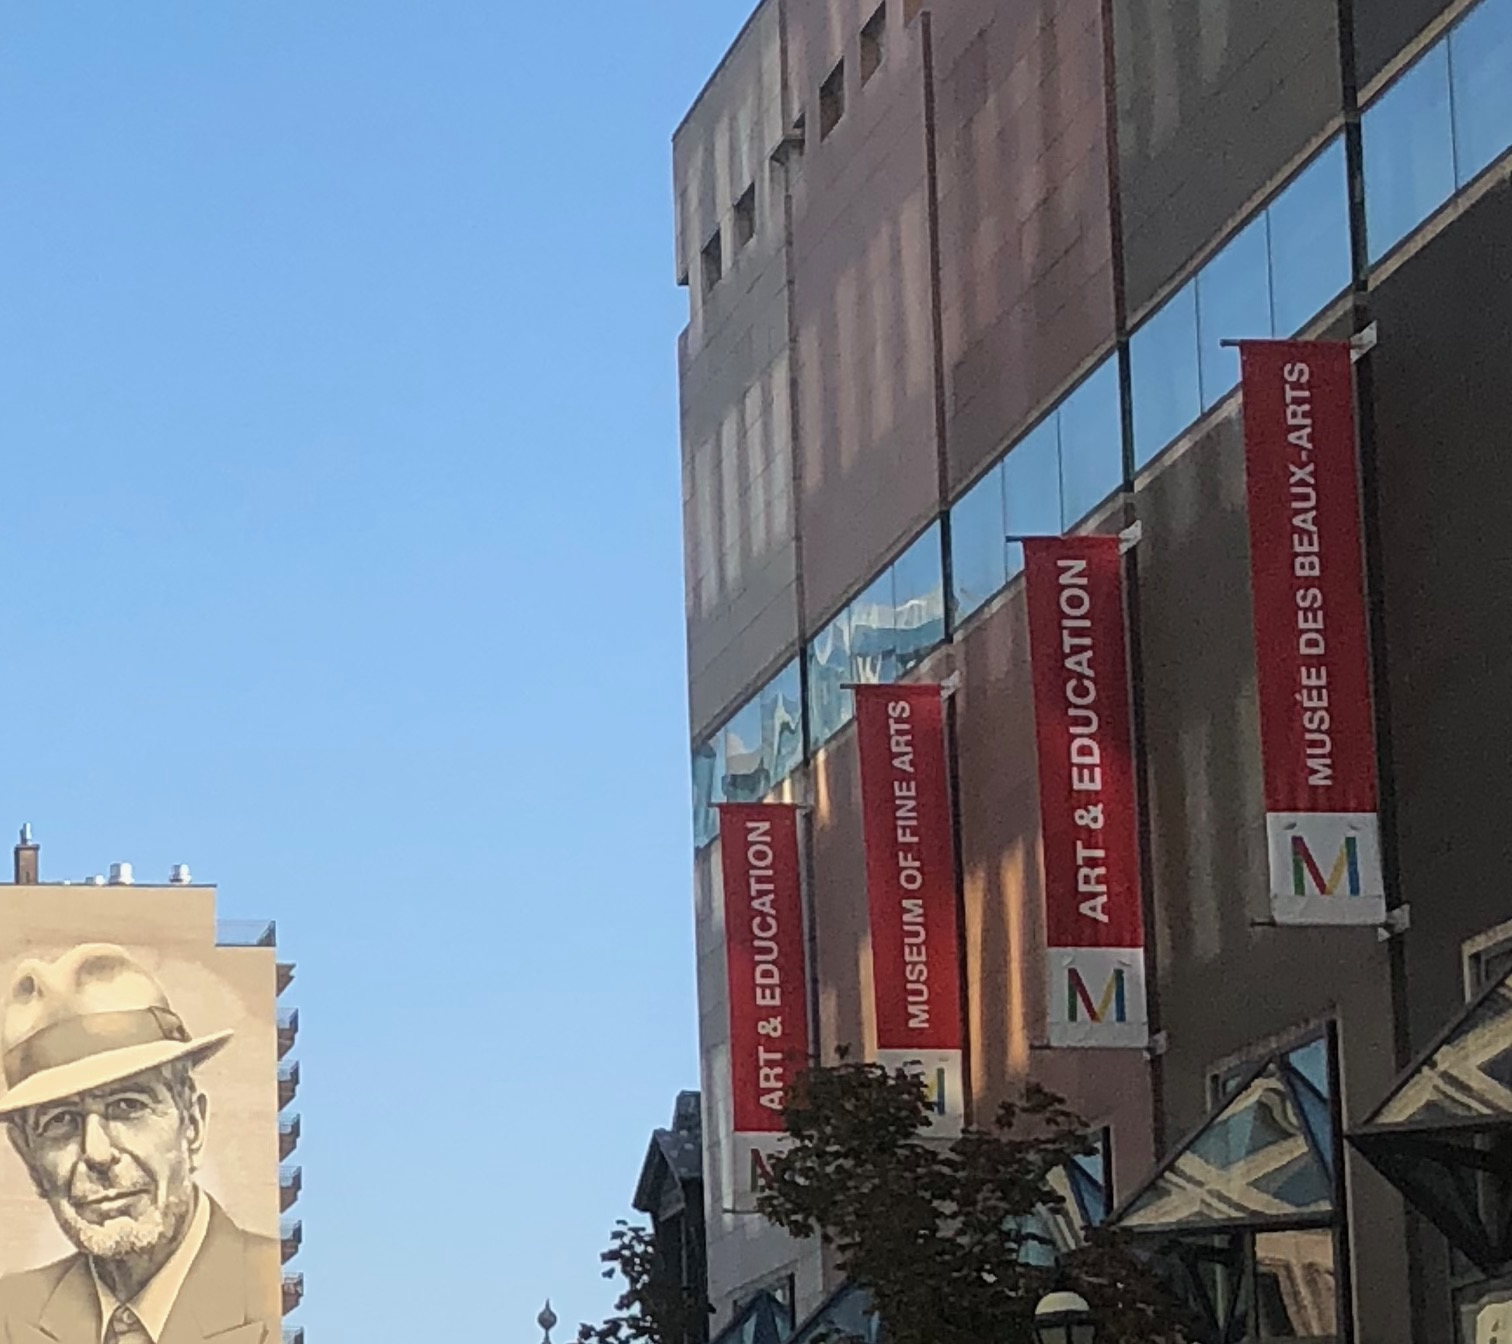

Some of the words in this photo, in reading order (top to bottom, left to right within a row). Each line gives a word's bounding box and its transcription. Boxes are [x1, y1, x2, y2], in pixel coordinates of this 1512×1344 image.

[1283, 362, 1321, 577] BEAUX-ARTS
[1296, 587, 1326, 656] DES
[1056, 559, 1103, 791] EDUCATION
[888, 700, 915, 773] ARTS
[1294, 666, 1333, 786] MUSÉE
[893, 781, 919, 843] FINE
[1074, 802, 1104, 830] &
[899, 851, 923, 890] OF
[1076, 840, 1109, 923] ART
[744, 821, 782, 1006] EDUCATION
[901, 899, 930, 1028] MUSEUM
[757, 1016, 782, 1038] &
[757, 1045, 784, 1111] ART
